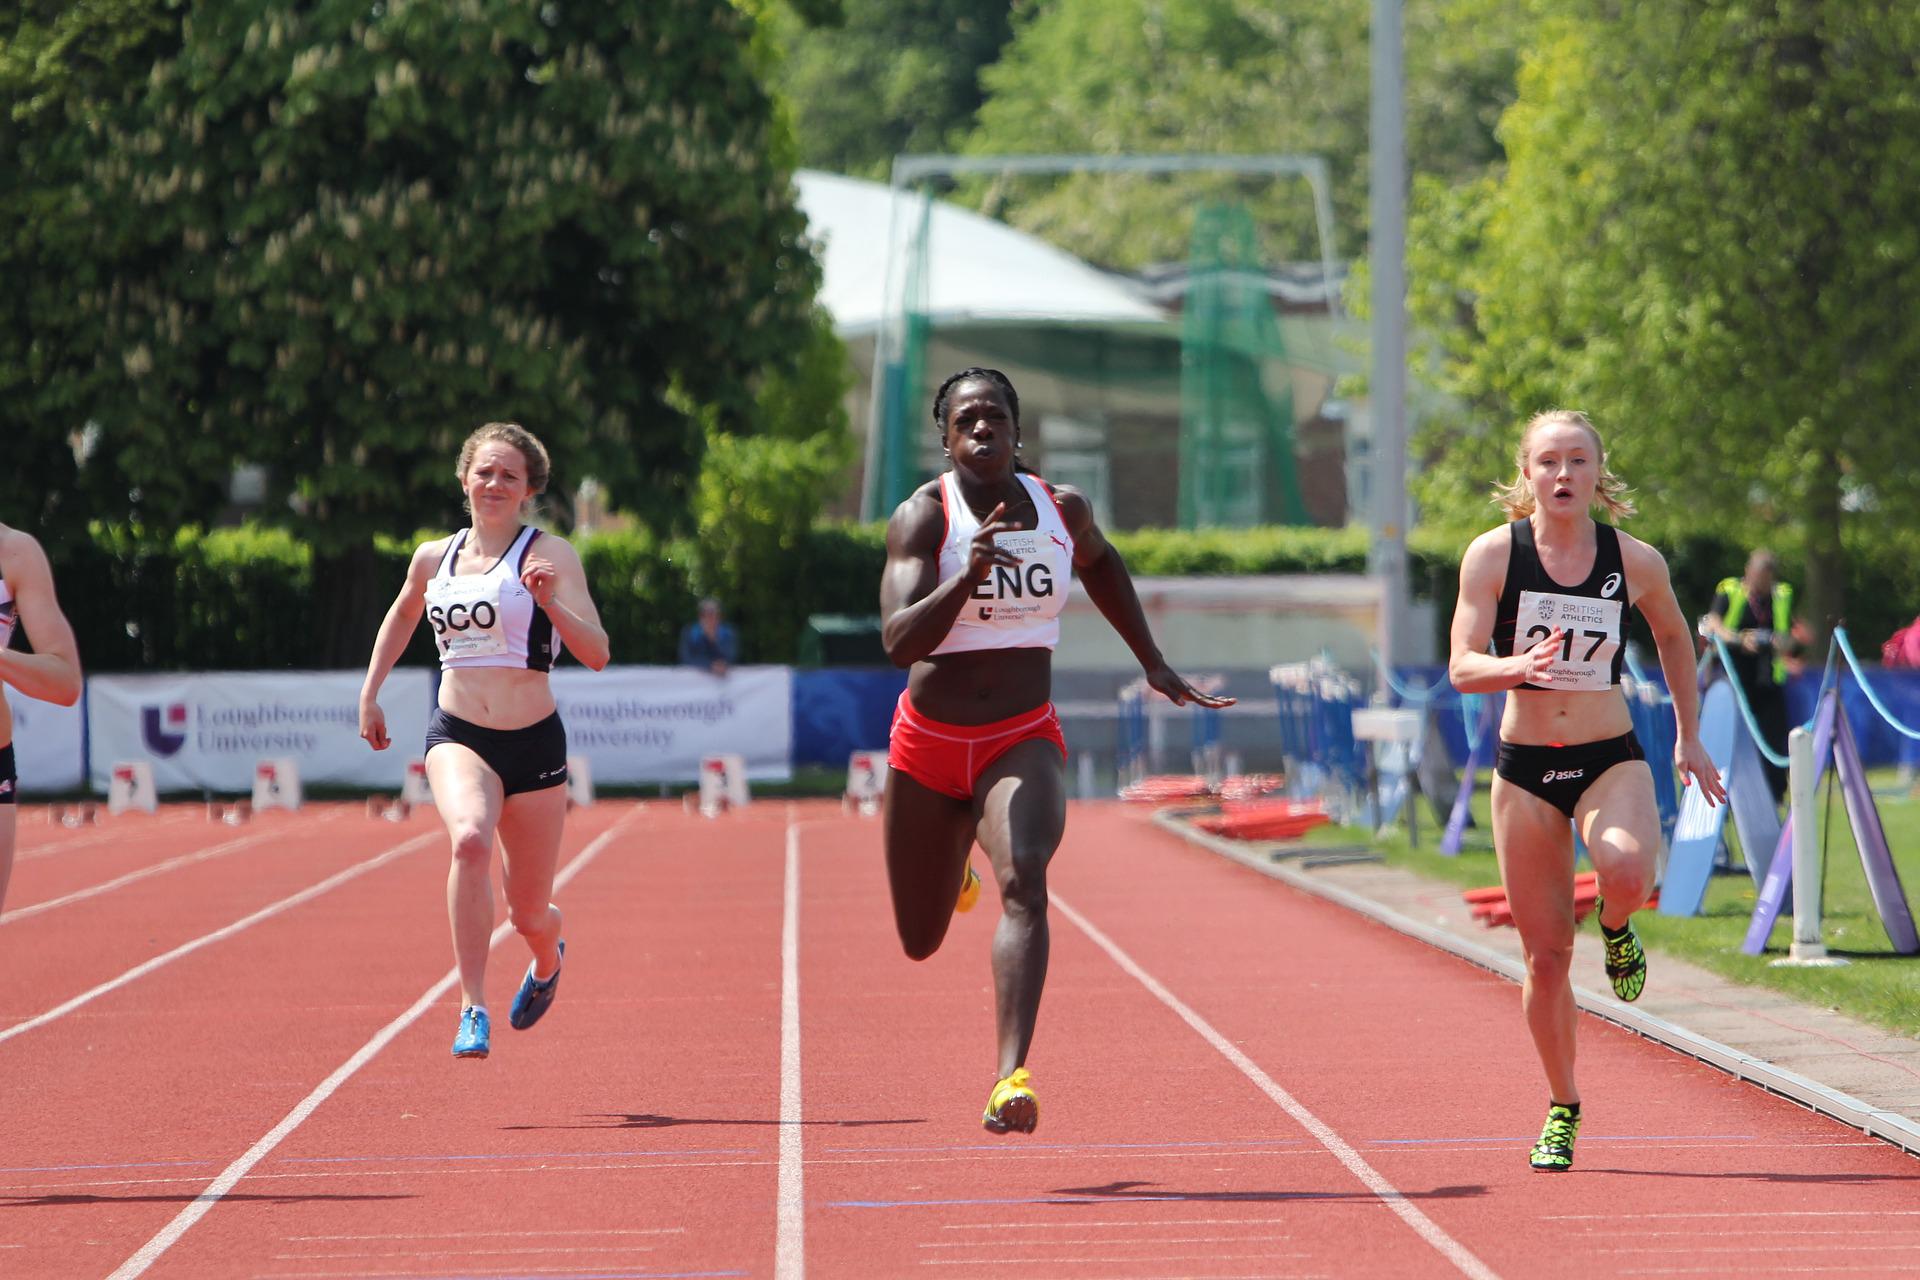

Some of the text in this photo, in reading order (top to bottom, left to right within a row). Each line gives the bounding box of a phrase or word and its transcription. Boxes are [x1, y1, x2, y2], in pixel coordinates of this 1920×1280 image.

[996, 538, 1034, 548] BRITISH
[971, 563, 1053, 600] ENG
[994, 604, 1041, 613] Loughborough
[1562, 603, 1603, 615] BRITISH
[430, 600, 496, 635] SCO
[1561, 614, 1603, 624] ATHLETICS
[1523, 624, 1608, 662] 217
[1545, 667, 1596, 678] Loughborough
[196, 731, 317, 755] University
[1556, 769, 1583, 780] asics
